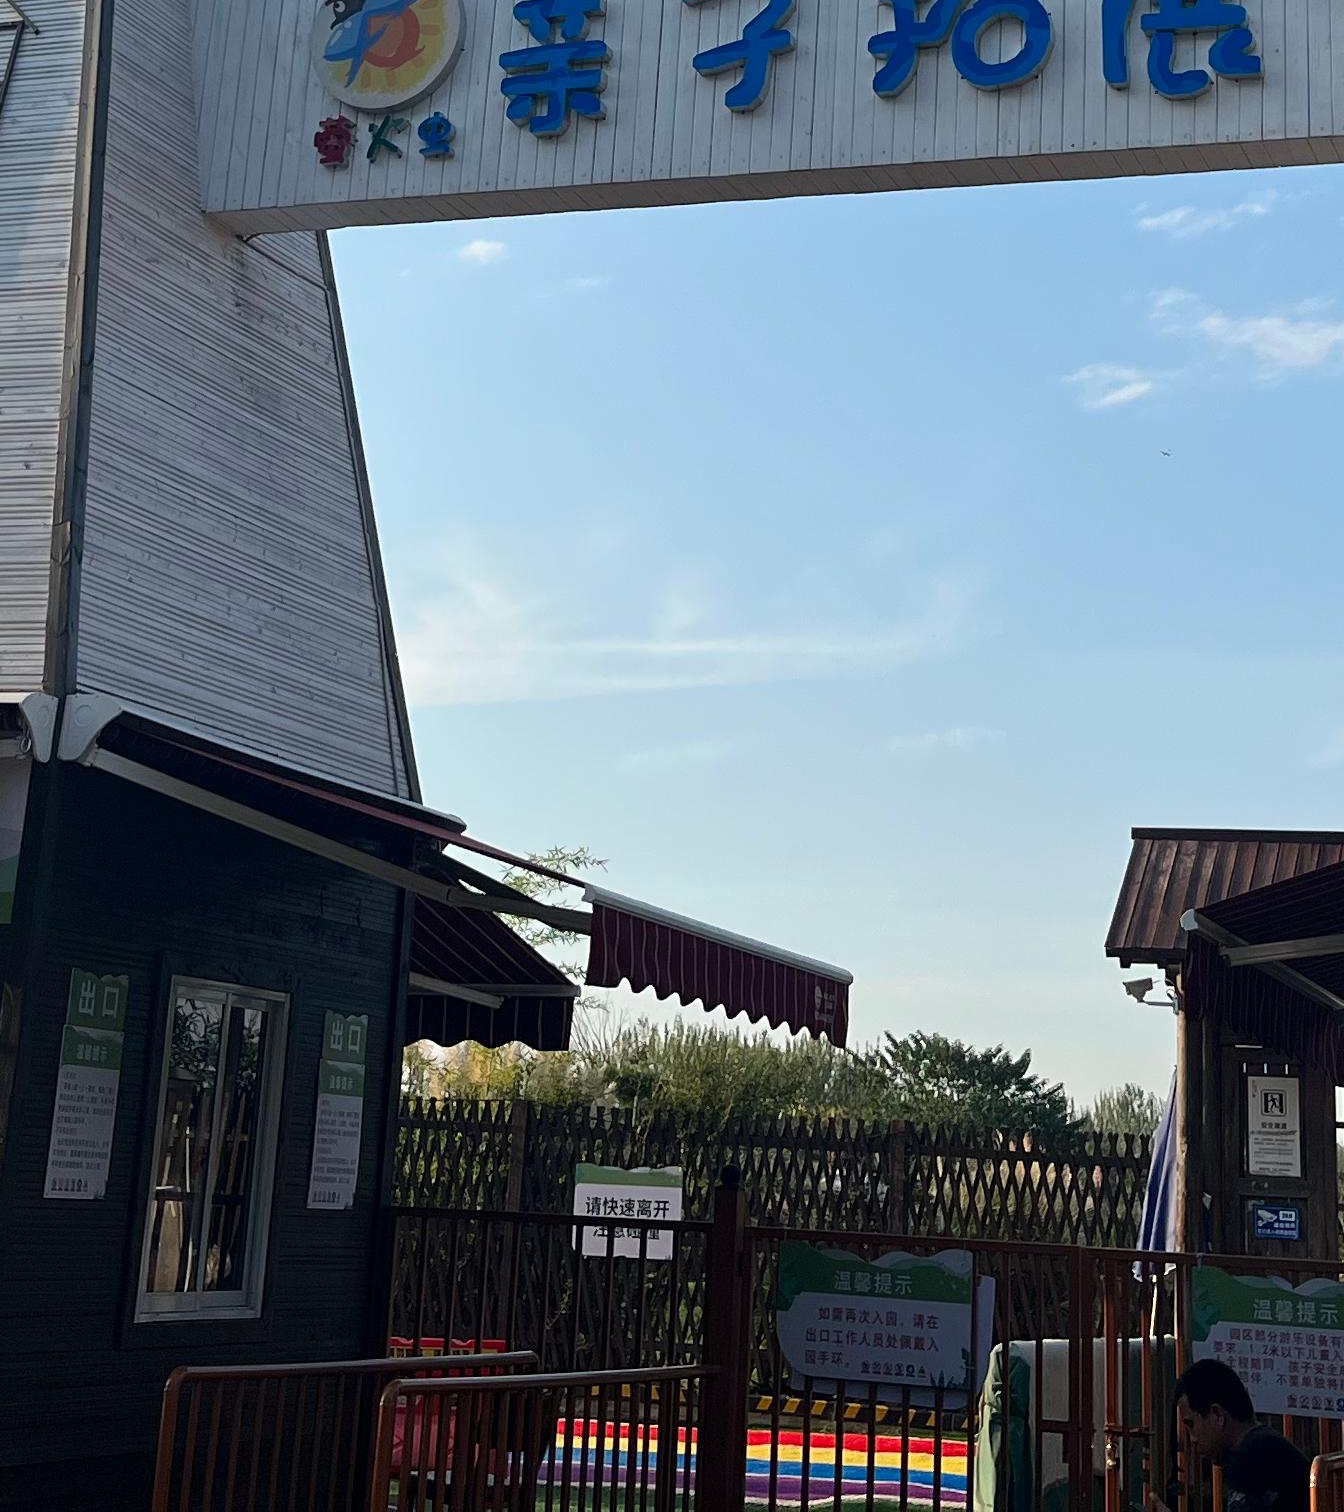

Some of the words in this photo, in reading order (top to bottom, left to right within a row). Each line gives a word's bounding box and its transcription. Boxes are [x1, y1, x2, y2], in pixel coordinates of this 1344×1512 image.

[78, 979, 120, 1018] 出口
[330, 1020, 361, 1054] 出口
[586, 1197, 670, 1219] 请快速离开
[834, 1271, 912, 1295] 温馨提示
[1253, 1299, 1340, 1325] 温馨提示
